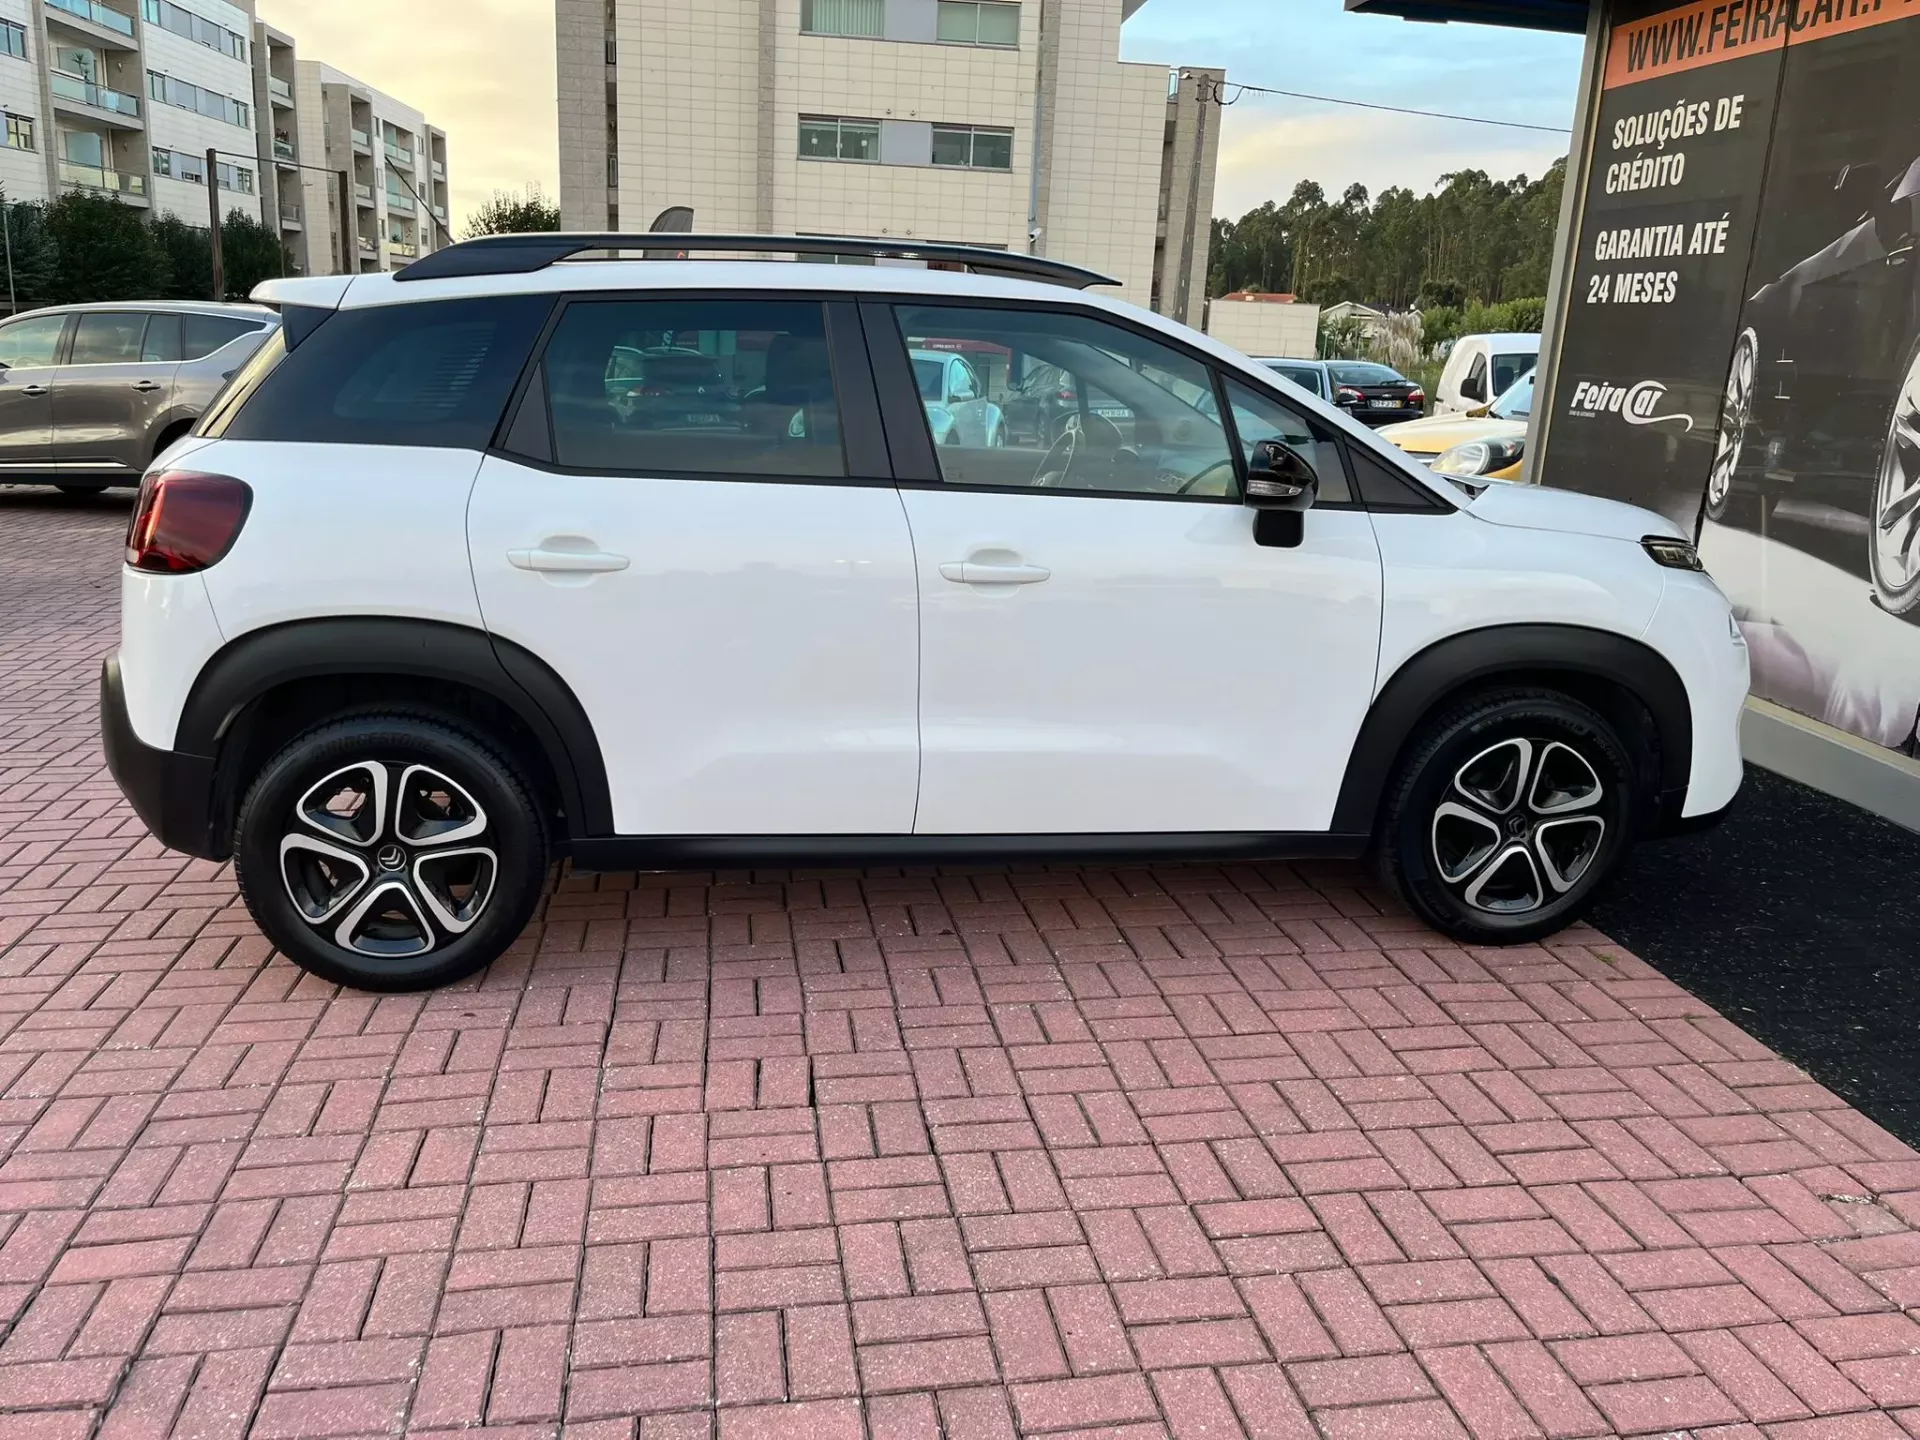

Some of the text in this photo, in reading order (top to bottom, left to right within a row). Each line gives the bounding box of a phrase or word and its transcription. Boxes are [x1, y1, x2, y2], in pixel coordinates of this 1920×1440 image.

[1612, 94, 1745, 150] SOLUÇÕES DE
[1605, 152, 1685, 195] CRÉDITO
[1595, 212, 1730, 261] GARANTIA ATÉ
[1586, 270, 1678, 304] 24 MESES
[1570, 380, 1693, 432] FeiraCar
